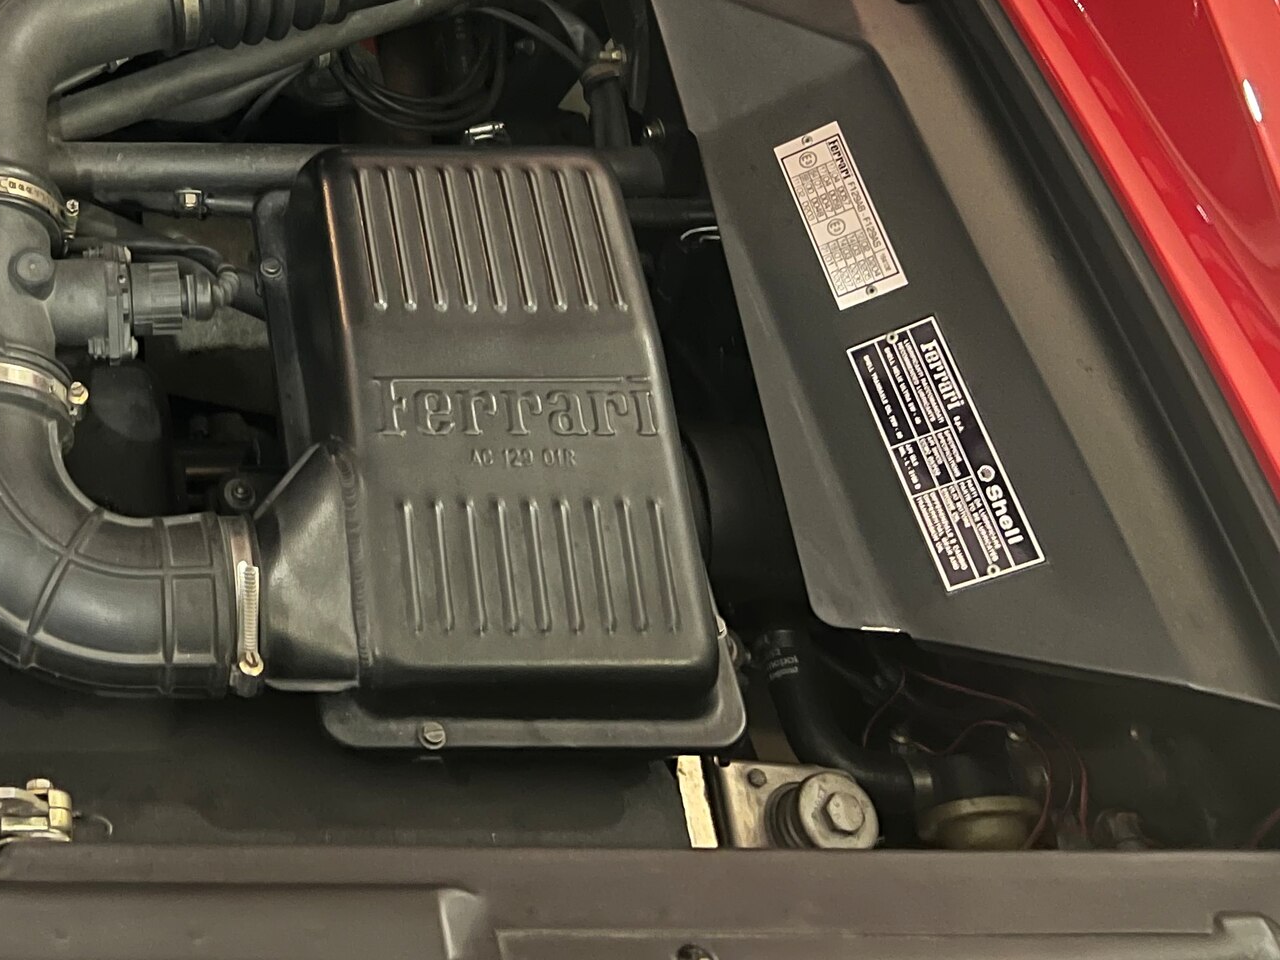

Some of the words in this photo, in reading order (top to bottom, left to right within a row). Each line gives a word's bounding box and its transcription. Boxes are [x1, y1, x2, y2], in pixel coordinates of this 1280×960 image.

[828, 138, 850, 179] Ferrari
[920, 339, 964, 409] Ferrari
[369, 375, 659, 437] Ferrari
[503, 448, 533, 467] 129
[985, 484, 1023, 544] Shell
